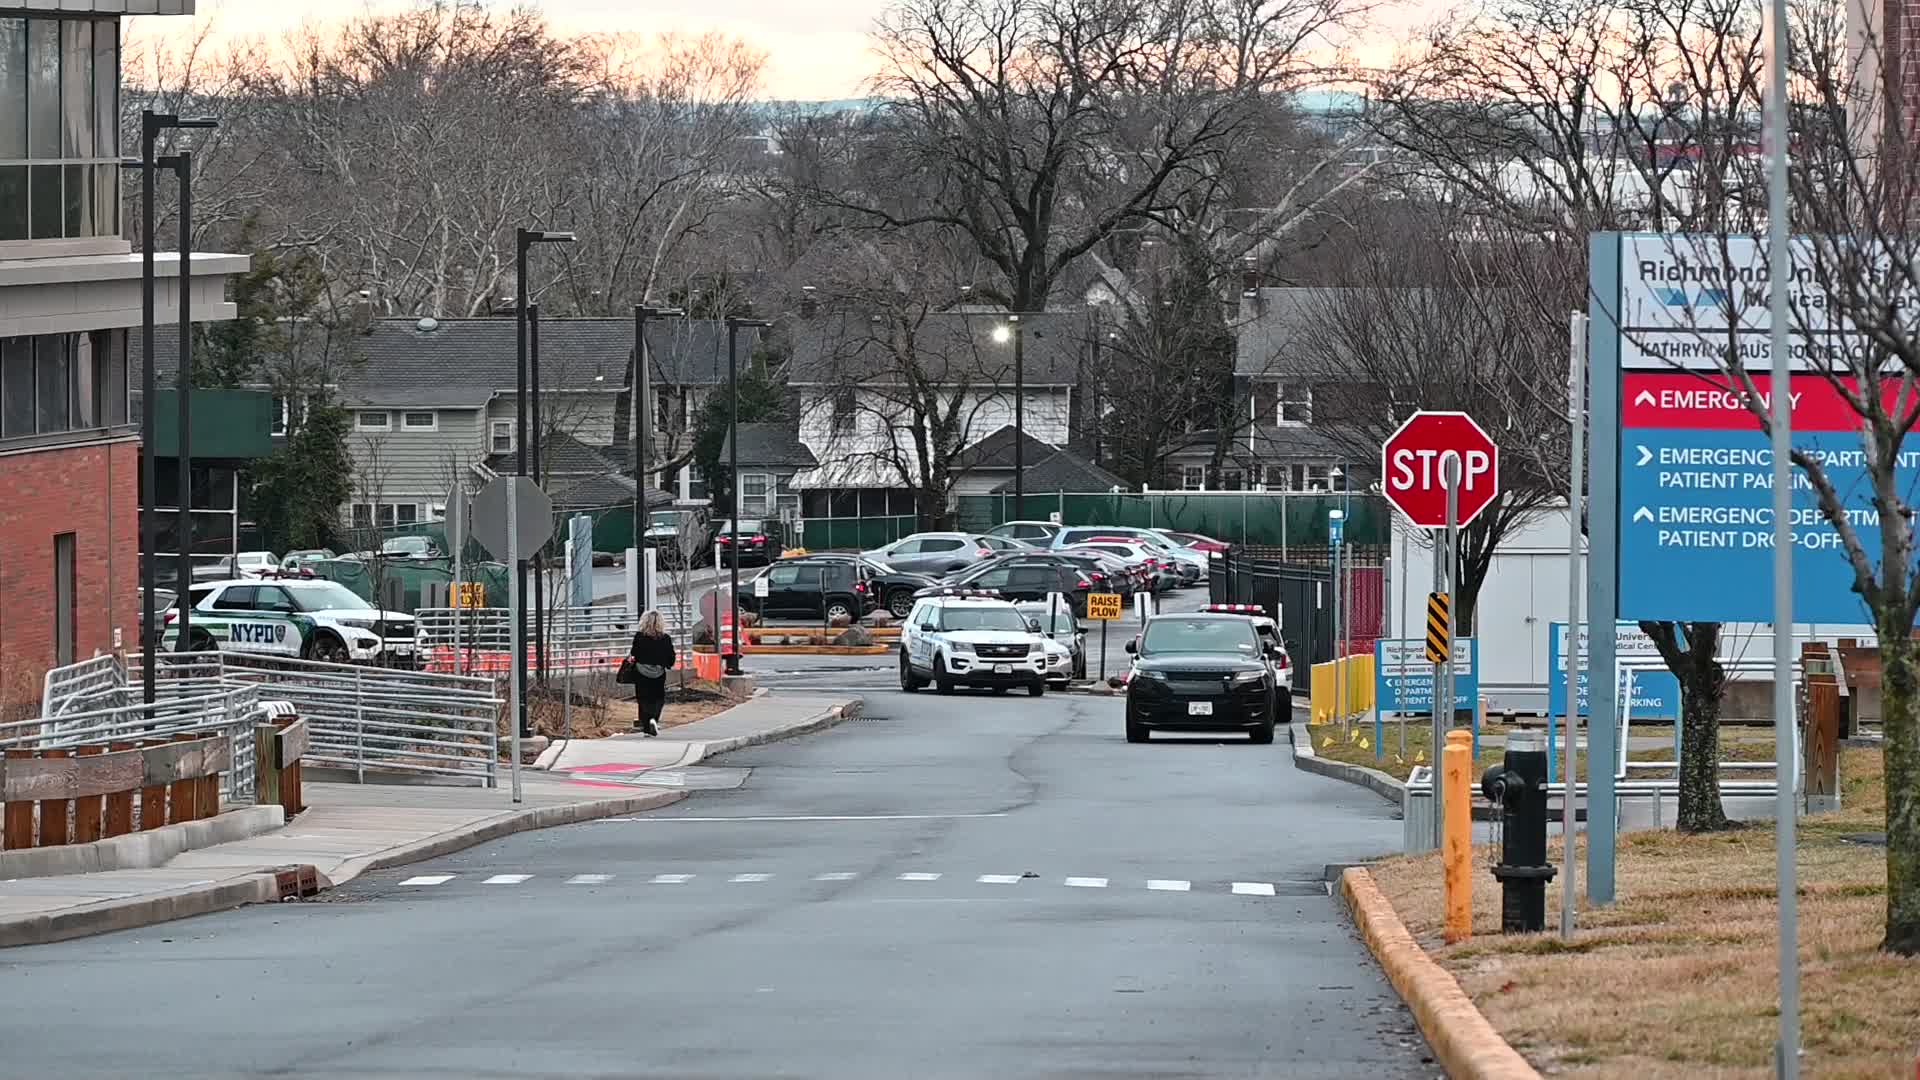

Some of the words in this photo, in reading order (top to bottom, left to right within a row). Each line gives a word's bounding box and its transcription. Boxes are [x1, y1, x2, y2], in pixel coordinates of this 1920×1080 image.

[1640, 260, 1770, 281] Richmond
[1640, 342, 1714, 358] KATHRYN
[1717, 343, 1774, 359] KAUS
[1660, 389, 1802, 410] EMERGENY
[1660, 447, 1777, 466] EMERGENC
[1391, 448, 1490, 491] STOP
[1659, 471, 1738, 488] PATIENT
[1657, 530, 1738, 548] PATIENT
[1090, 594, 1119, 605] RAISE
[1090, 606, 1118, 617] PLOW
[231, 624, 274, 643] NYPD
